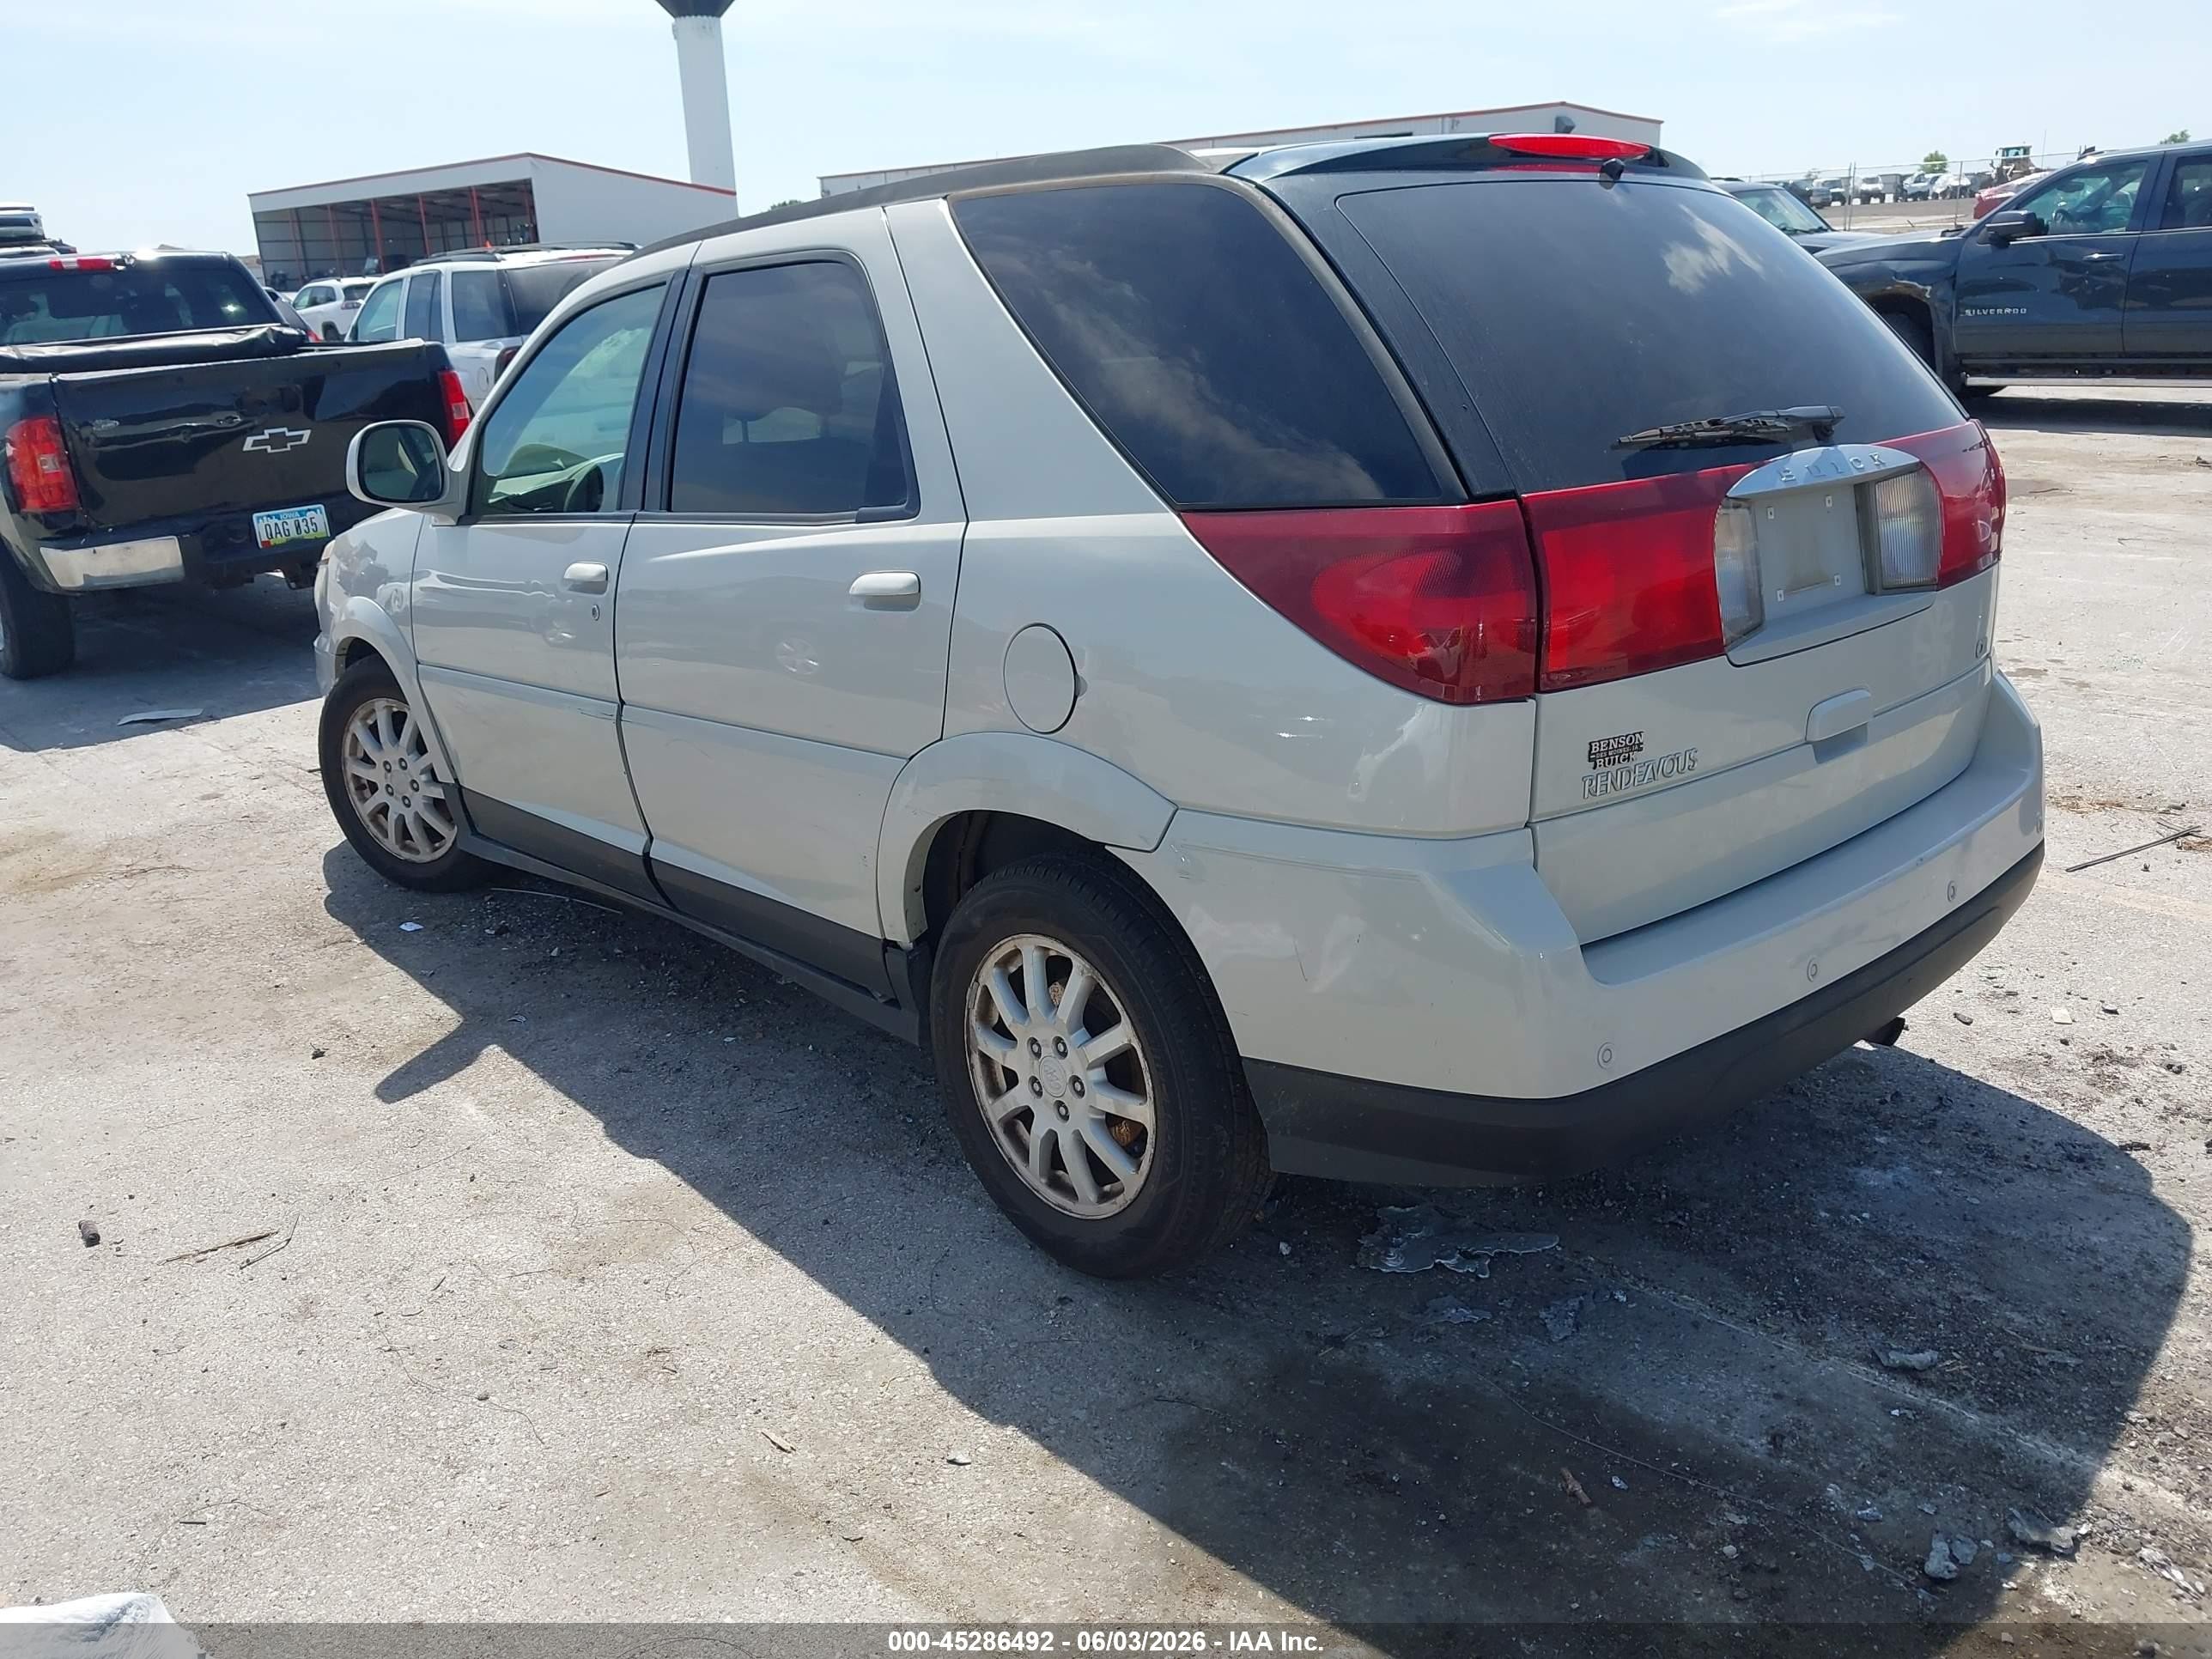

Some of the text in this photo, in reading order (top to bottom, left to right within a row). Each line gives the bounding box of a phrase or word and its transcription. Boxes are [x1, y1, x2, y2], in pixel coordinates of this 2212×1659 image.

[1964, 307, 2027, 317] SILVERADO
[1779, 452, 1887, 482] BUICK
[280, 511, 301, 520] IOWA
[264, 520, 290, 540] QAG
[1590, 732, 1644, 753] BENSON
[1595, 751, 1636, 769] BUICK
